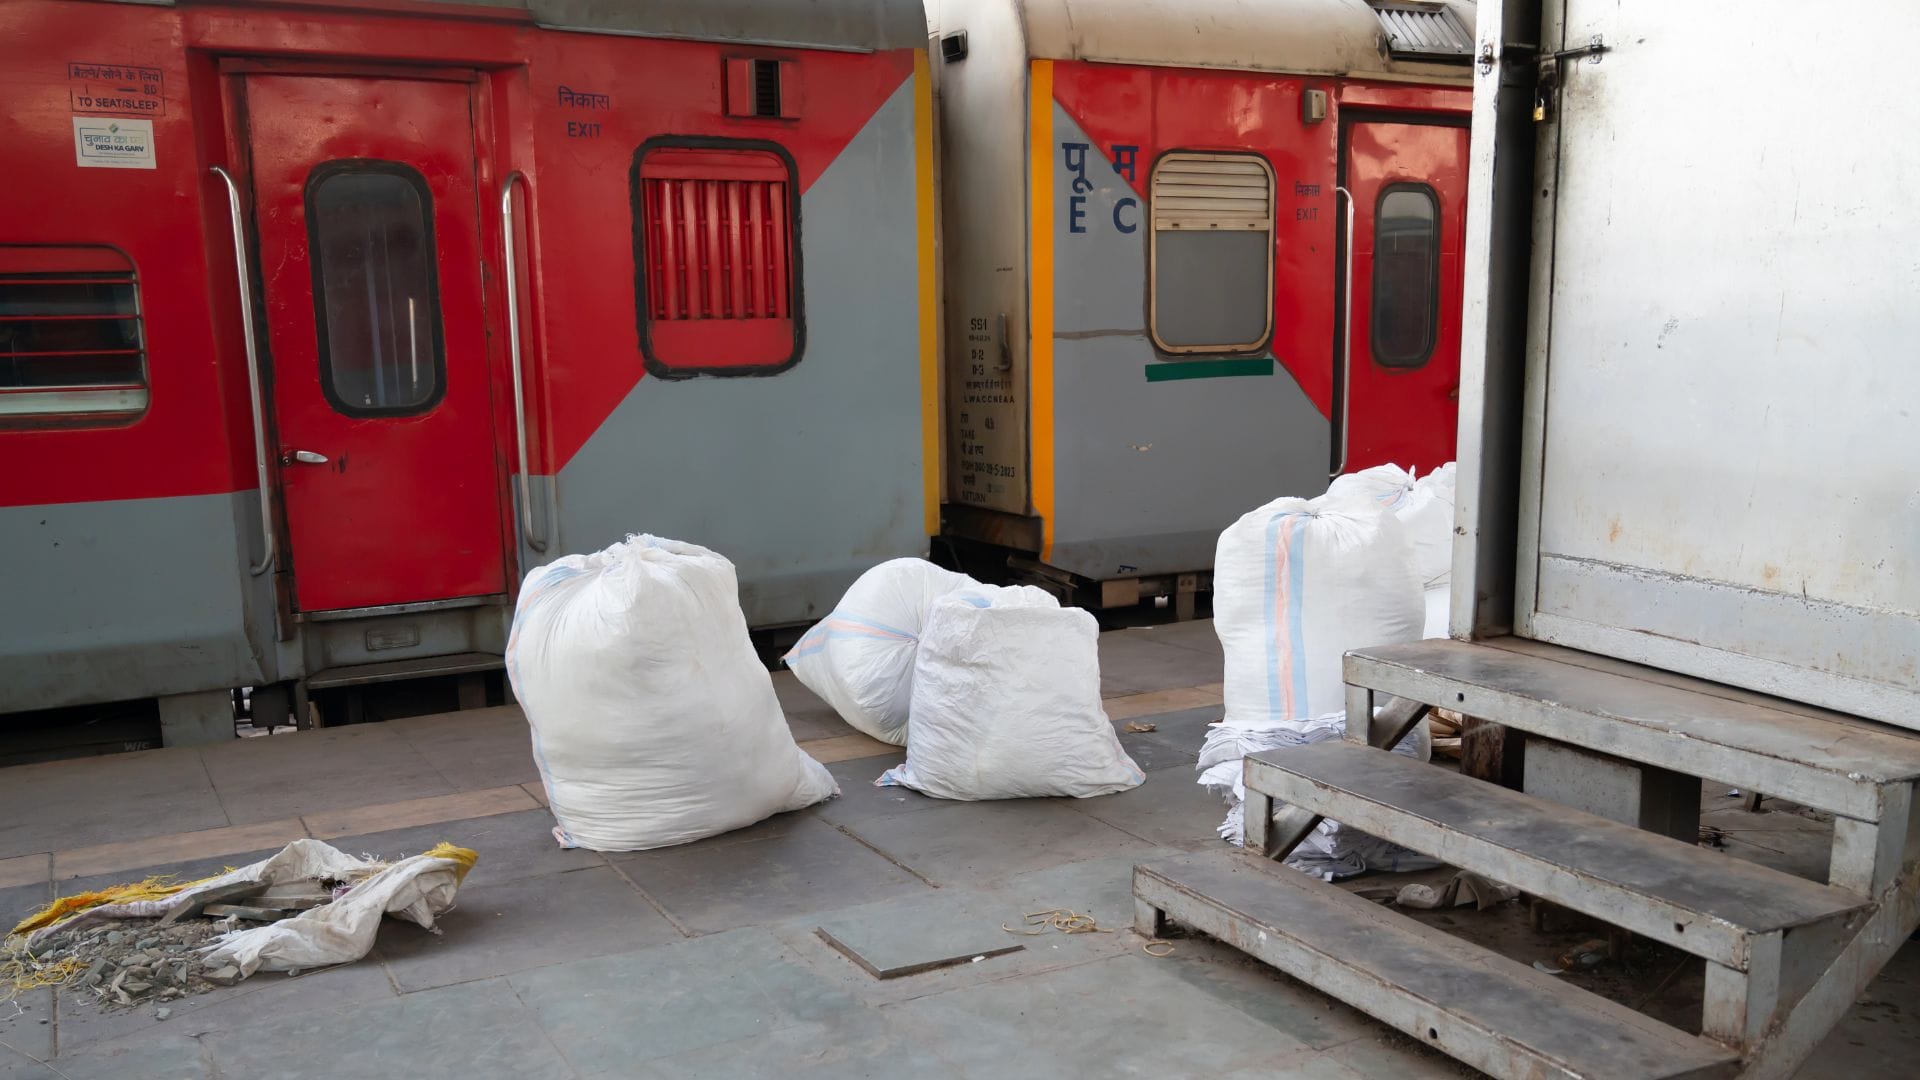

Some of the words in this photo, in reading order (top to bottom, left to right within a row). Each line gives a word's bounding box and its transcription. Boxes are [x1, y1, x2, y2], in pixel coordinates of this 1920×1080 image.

[78, 96, 92, 108] TO
[95, 98, 159, 110] SEAT/SLEEP
[559, 85, 609, 111] निकास
[567, 121, 601, 138] EXIT
[1062, 142, 1093, 193] पू
[1111, 144, 1139, 182] म
[1069, 196, 1086, 233] E
[1112, 197, 1137, 234] C
[1296, 207, 1318, 223] EXIT
